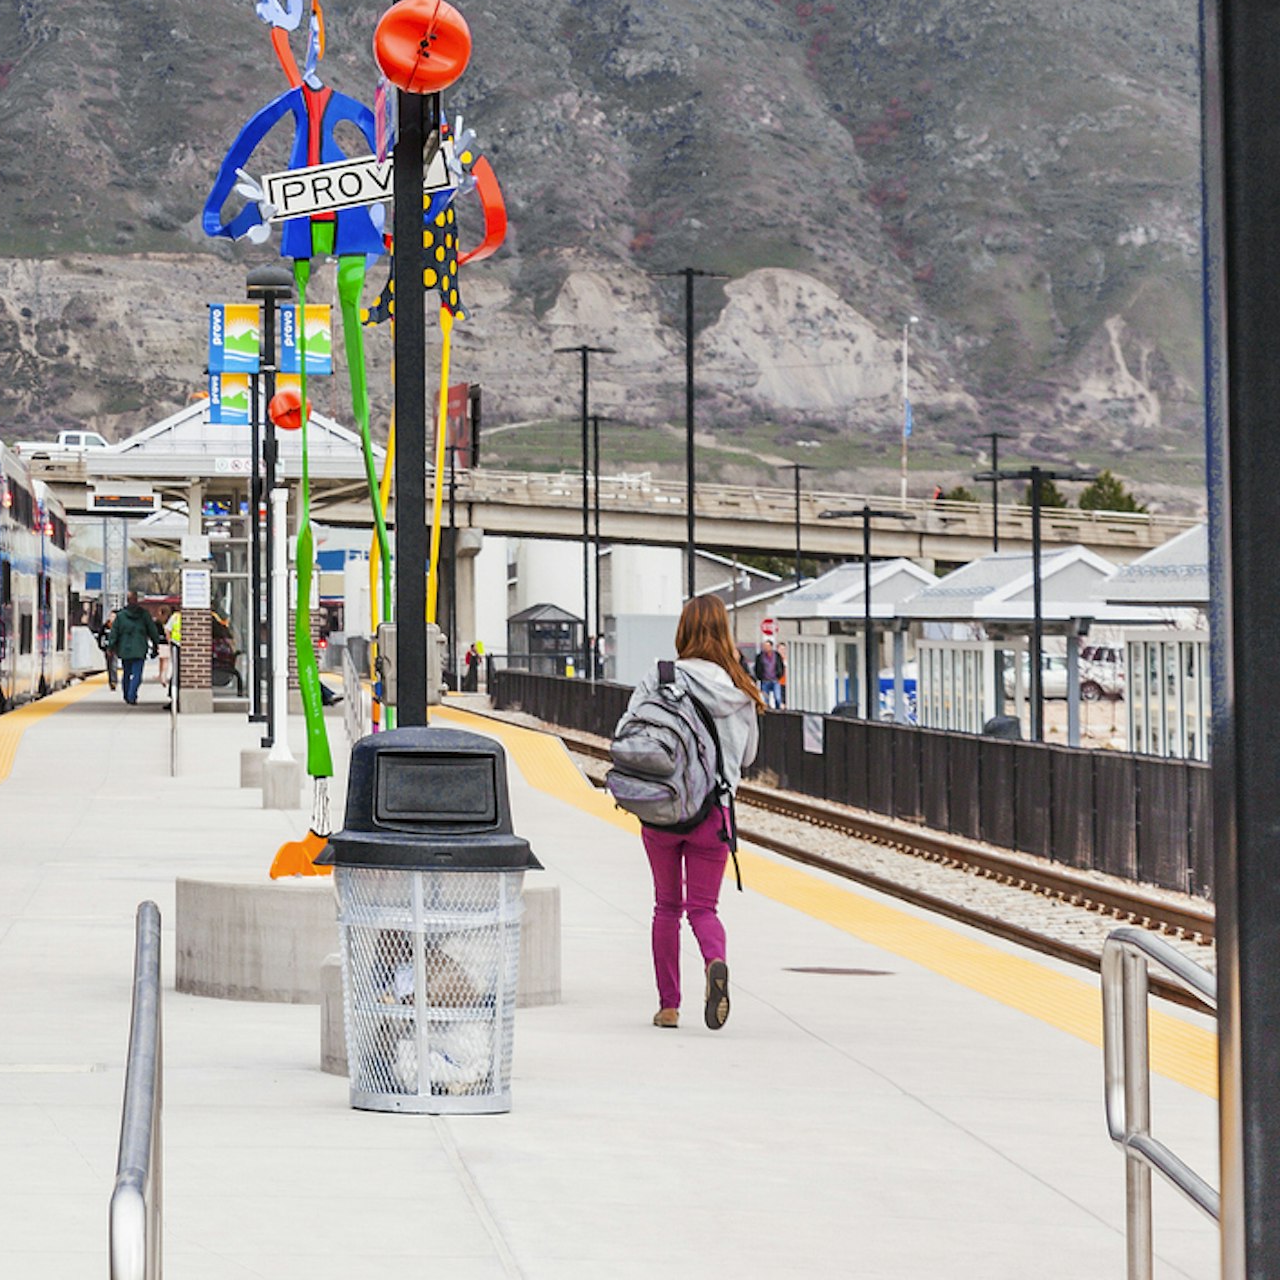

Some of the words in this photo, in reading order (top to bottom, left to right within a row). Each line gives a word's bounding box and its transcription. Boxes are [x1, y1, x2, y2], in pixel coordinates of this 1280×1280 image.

[282, 163, 395, 210] PROV
[212, 308, 223, 346] provo
[283, 310, 294, 347] provo
